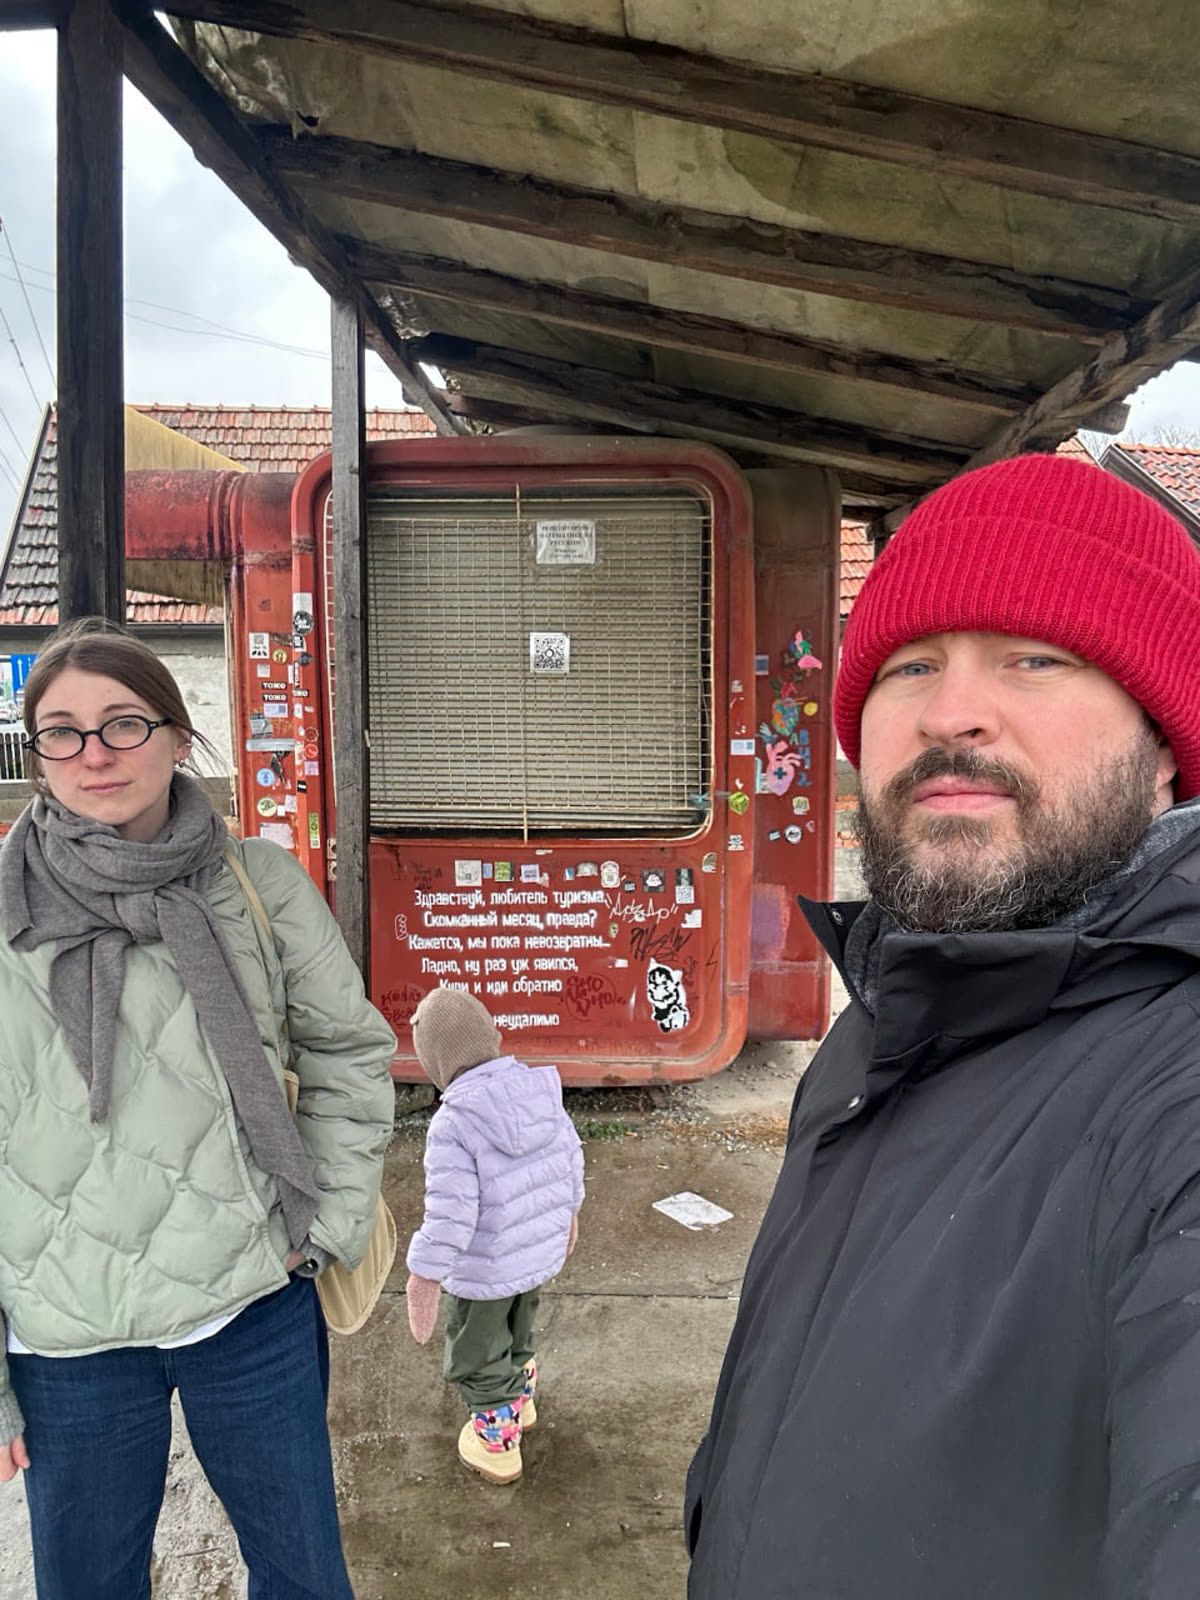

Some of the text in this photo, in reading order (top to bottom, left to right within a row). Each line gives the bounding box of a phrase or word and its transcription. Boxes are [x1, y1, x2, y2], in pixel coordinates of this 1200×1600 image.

[414, 889, 486, 909] Здравствуй,
[490, 888, 548, 905] любитель
[424, 909, 598, 930] Скомканный месяц, правда?
[408, 933, 463, 953] Кажется,
[467, 936, 487, 950] мы
[491, 935, 520, 949] пока
[421, 957, 579, 975] Ладно, ну раз уж явился,
[474, 981, 482, 994] и
[486, 981, 508, 995] иди
[513, 975, 563, 997] обратно
[493, 1013, 560, 1030] неудалимо
